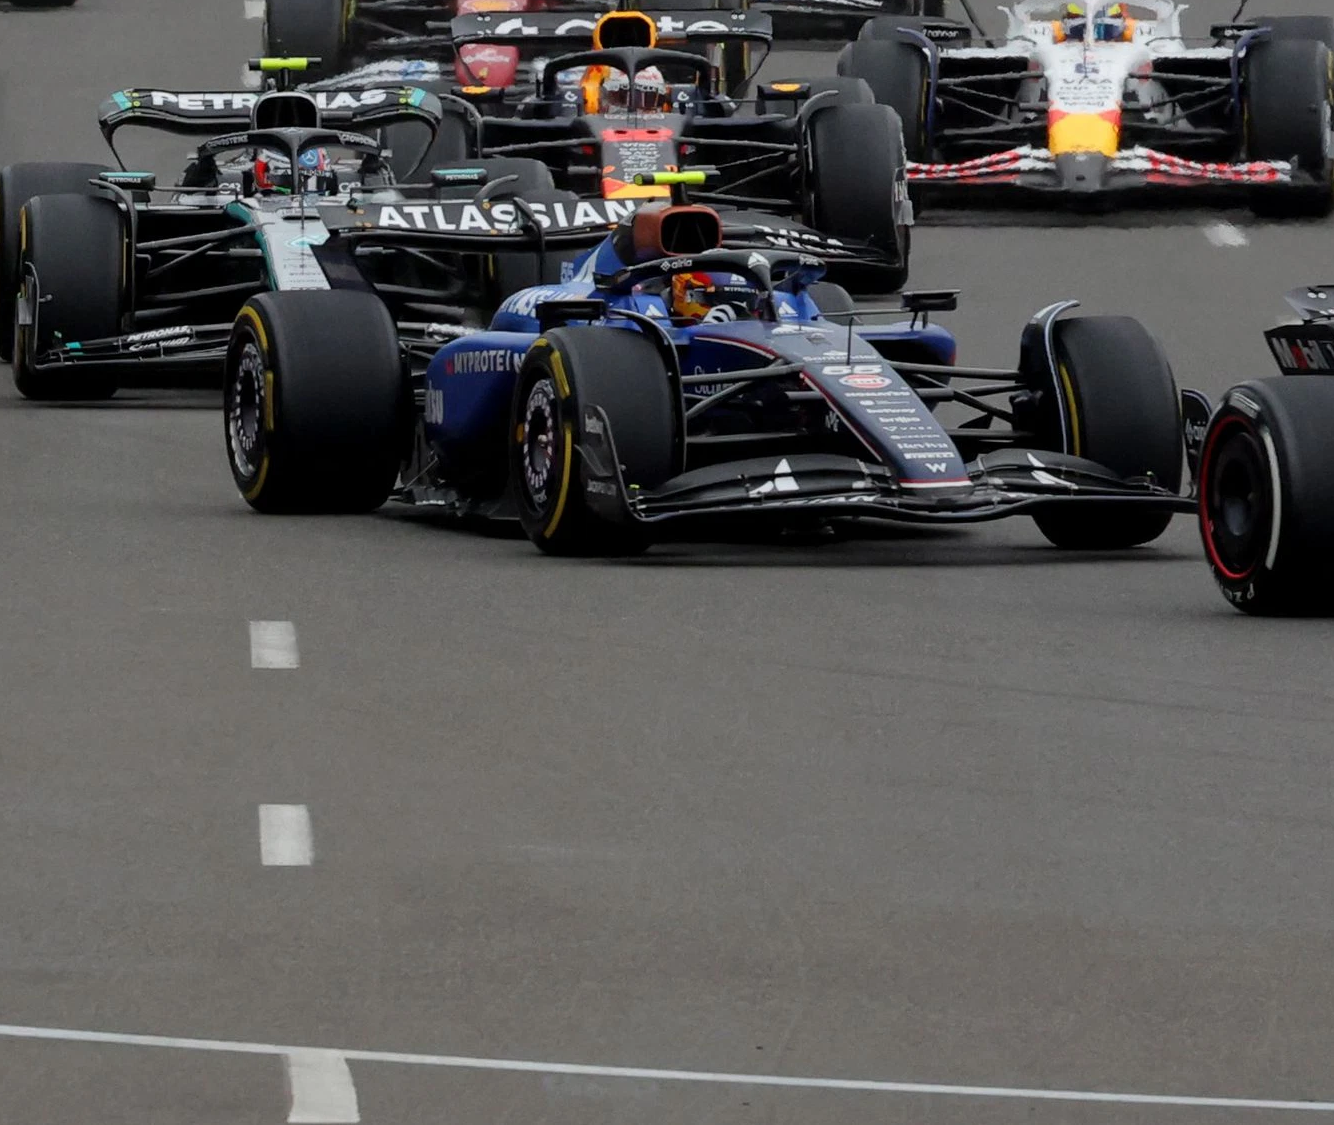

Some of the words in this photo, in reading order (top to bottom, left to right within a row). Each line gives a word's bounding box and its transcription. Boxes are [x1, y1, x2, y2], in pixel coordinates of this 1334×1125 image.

[151, 88, 388, 110] PETRAS
[127, 325, 190, 343] PETRONAS
[453, 349, 527, 375] MYPROTEIN
[1271, 336, 1329, 370] Mobil
[822, 364, 883, 375] 55
